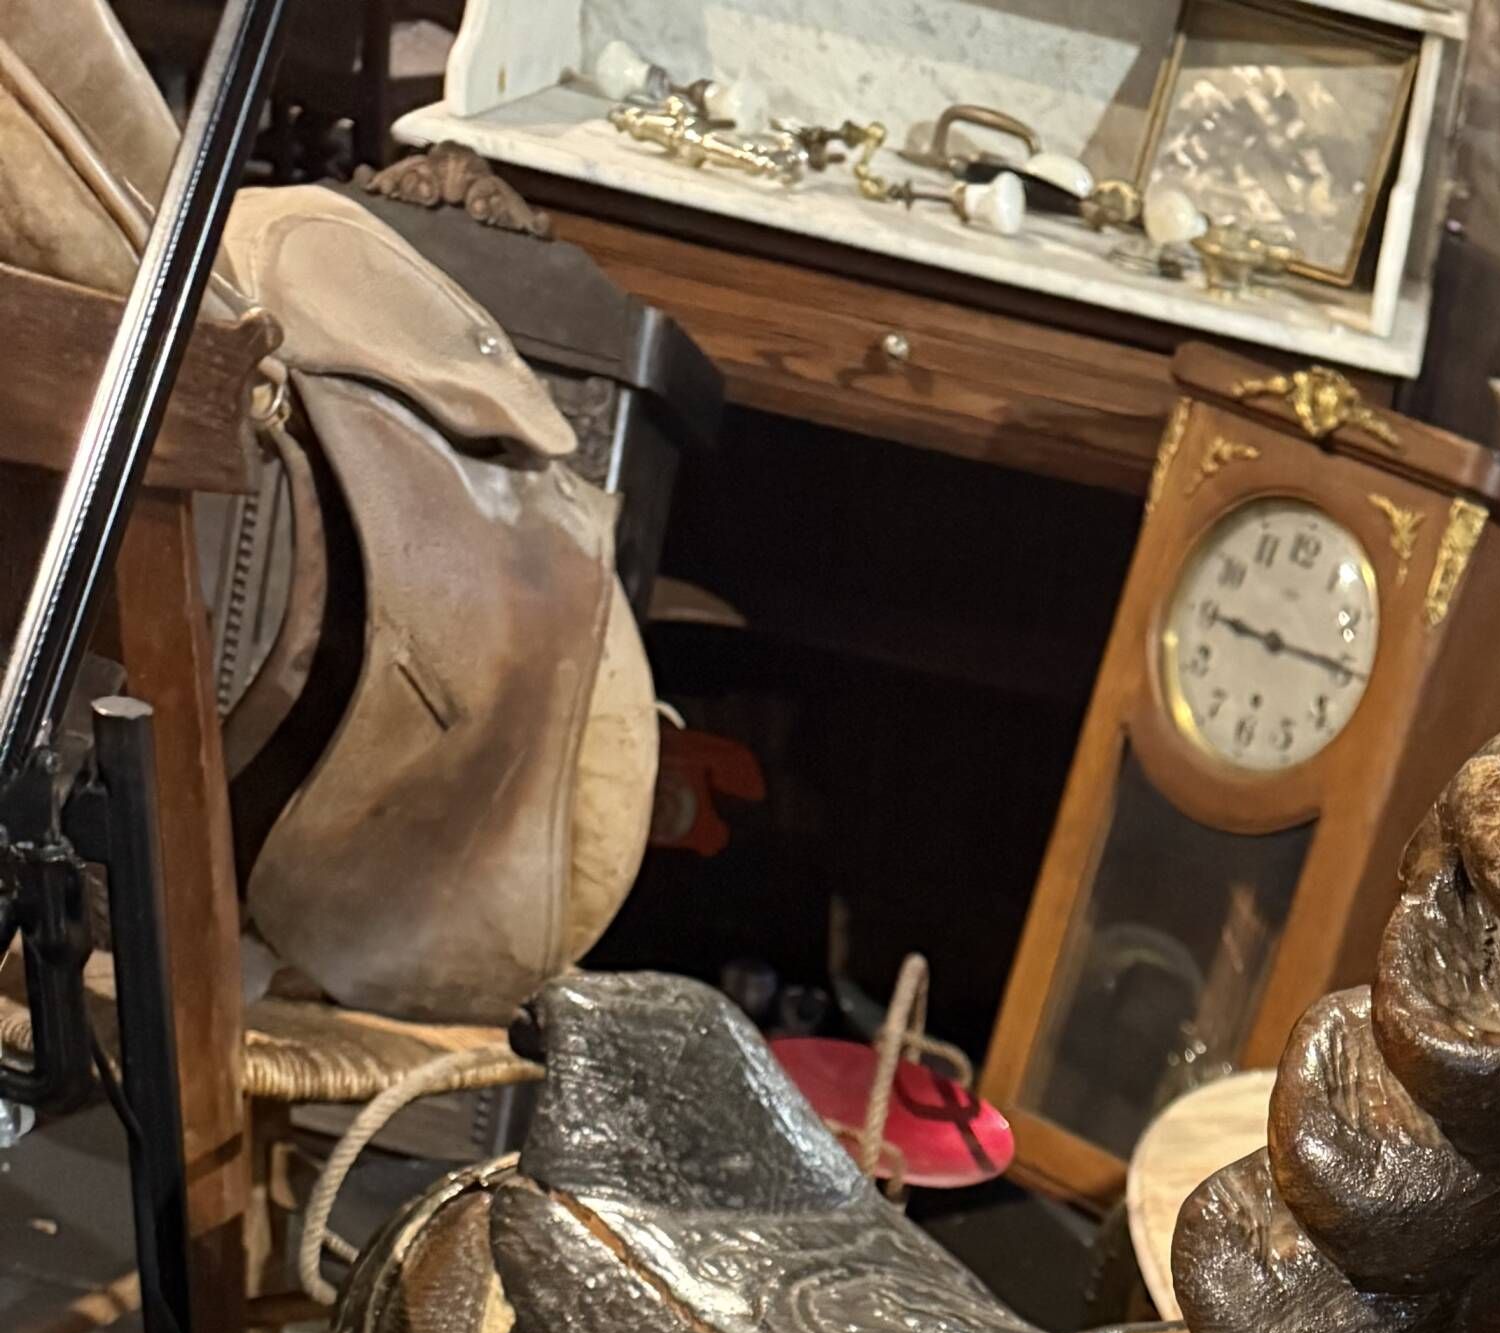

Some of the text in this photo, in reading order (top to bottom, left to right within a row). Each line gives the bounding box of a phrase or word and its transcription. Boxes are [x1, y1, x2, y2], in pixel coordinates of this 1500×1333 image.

[1254, 534, 1280, 568] 11
[1288, 533, 1322, 570] 12
[1233, 716, 1257, 748] 6
